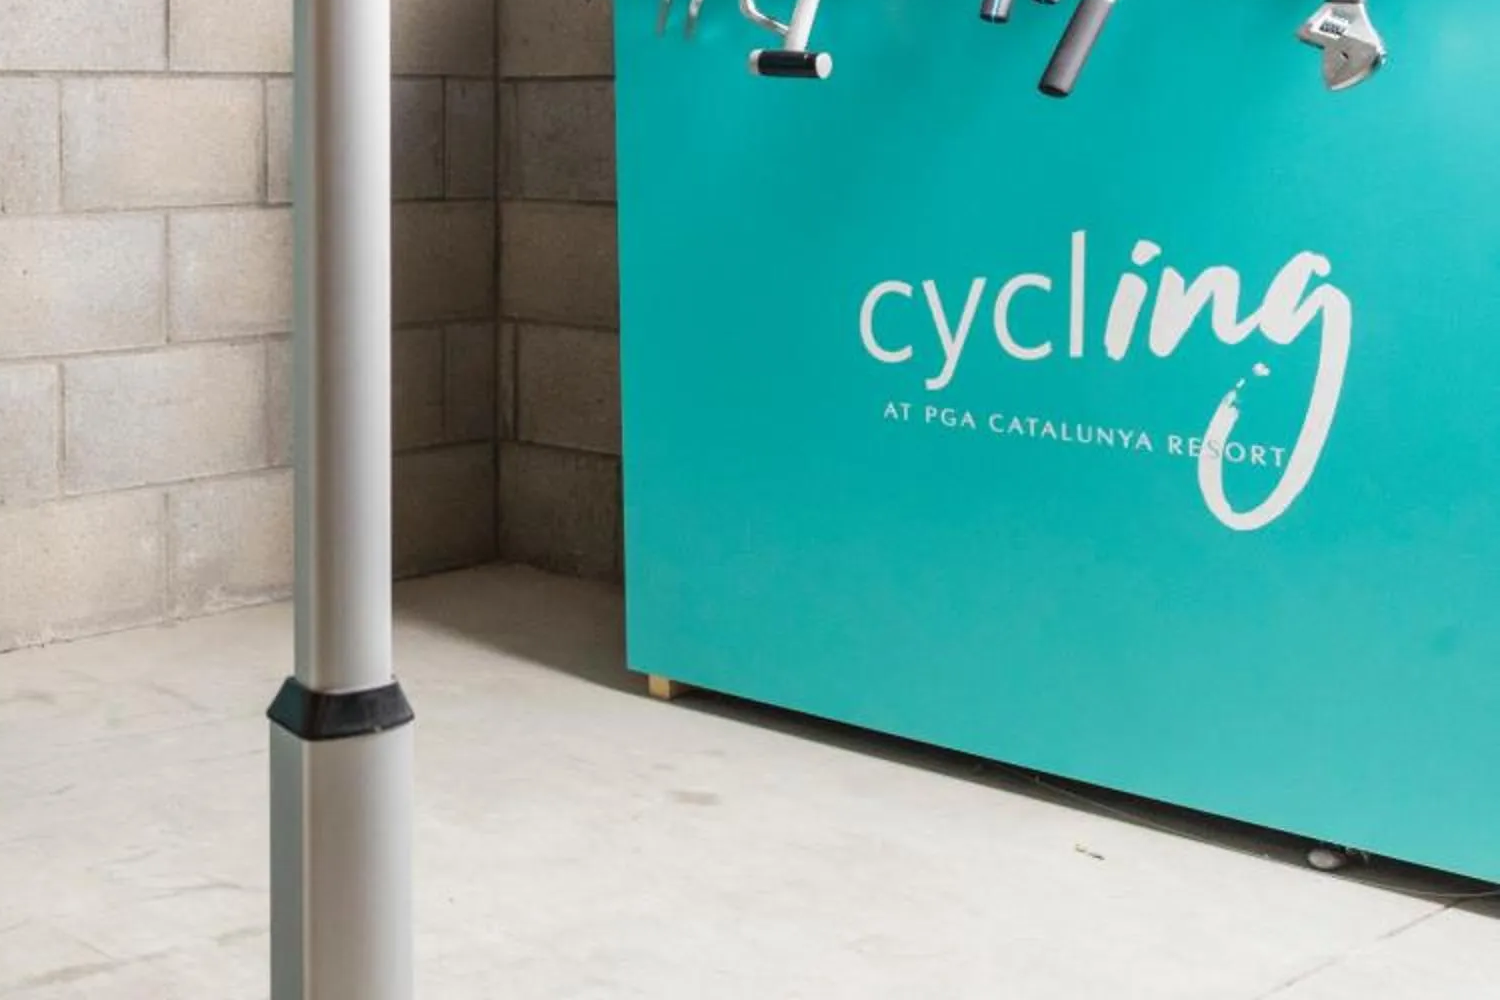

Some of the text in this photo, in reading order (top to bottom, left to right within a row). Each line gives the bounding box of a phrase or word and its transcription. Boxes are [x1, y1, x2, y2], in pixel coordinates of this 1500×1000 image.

[858, 229, 1352, 533] cycling
[882, 400, 1286, 468] AT PGA CATALUNYA RESORT
